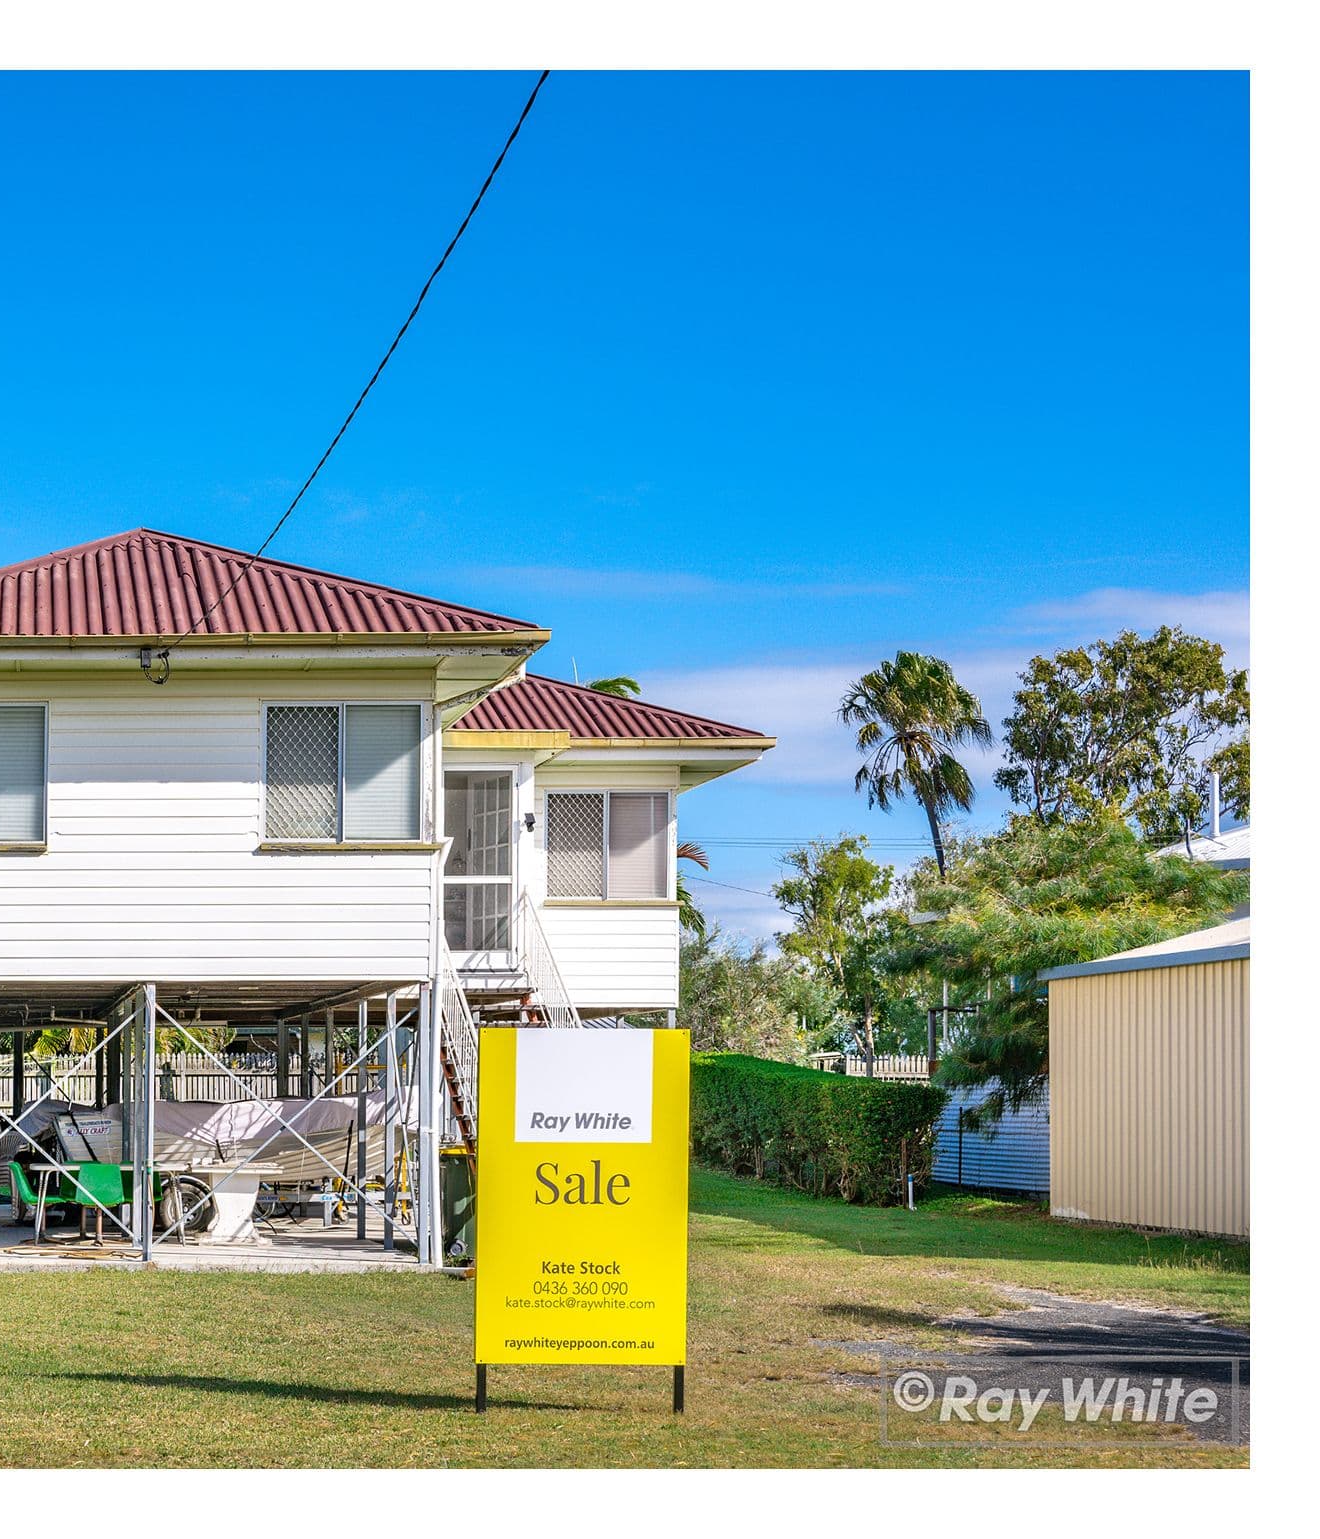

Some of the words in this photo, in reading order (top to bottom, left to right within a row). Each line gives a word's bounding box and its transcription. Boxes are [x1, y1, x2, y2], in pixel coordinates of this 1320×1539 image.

[530, 1111, 571, 1133] Ray
[575, 1112, 632, 1130] White
[534, 1159, 631, 1206] Sale
[541, 1260, 576, 1275] Kate
[579, 1260, 621, 1275] Stock
[533, 1281, 568, 1296] 0436
[571, 1281, 599, 1296] 360
[601, 1281, 629, 1296] 090
[505, 1296, 656, 1312] kate.stock@raywhite.com
[504, 1336, 655, 1351] raywhiteyeppoon.com.au
